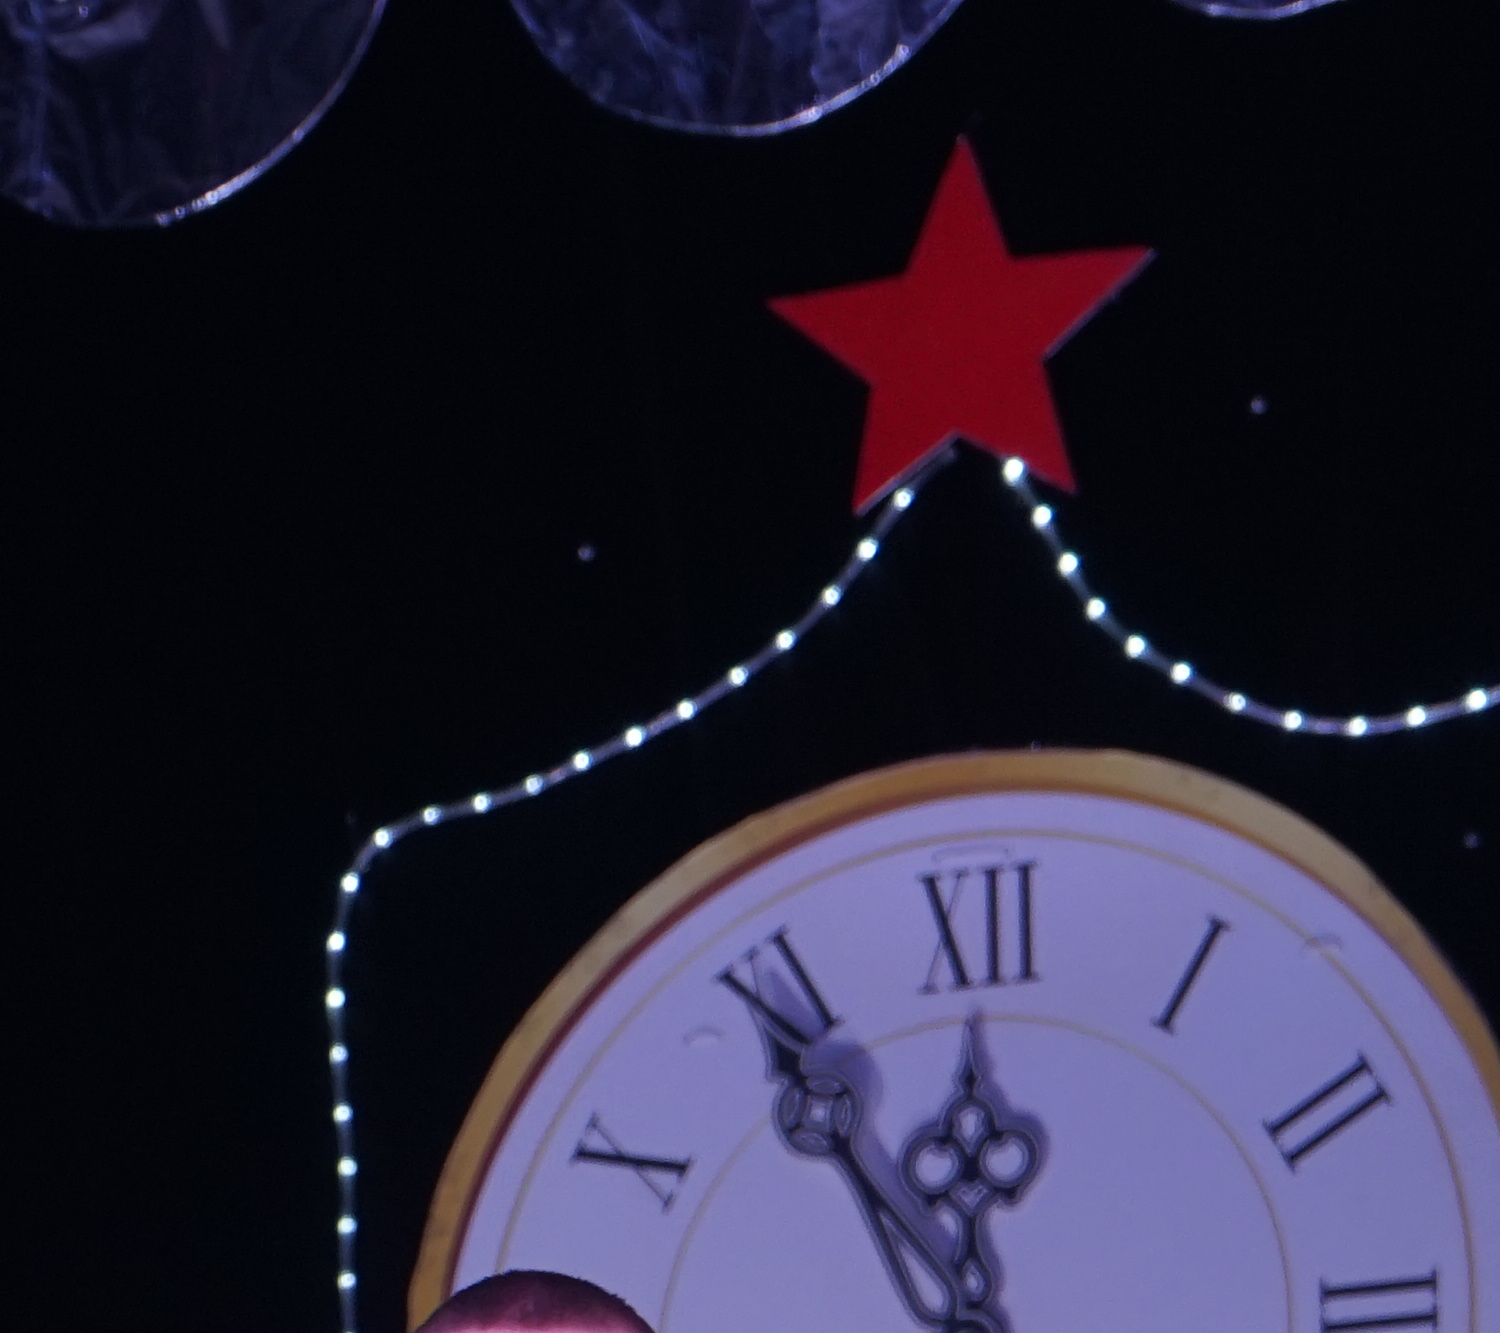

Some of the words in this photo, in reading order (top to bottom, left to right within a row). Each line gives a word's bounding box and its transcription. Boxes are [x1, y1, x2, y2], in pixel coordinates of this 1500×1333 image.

[916, 862, 1042, 996] XII
[570, 1112, 692, 1212] X
[1262, 1052, 1394, 1173] II
